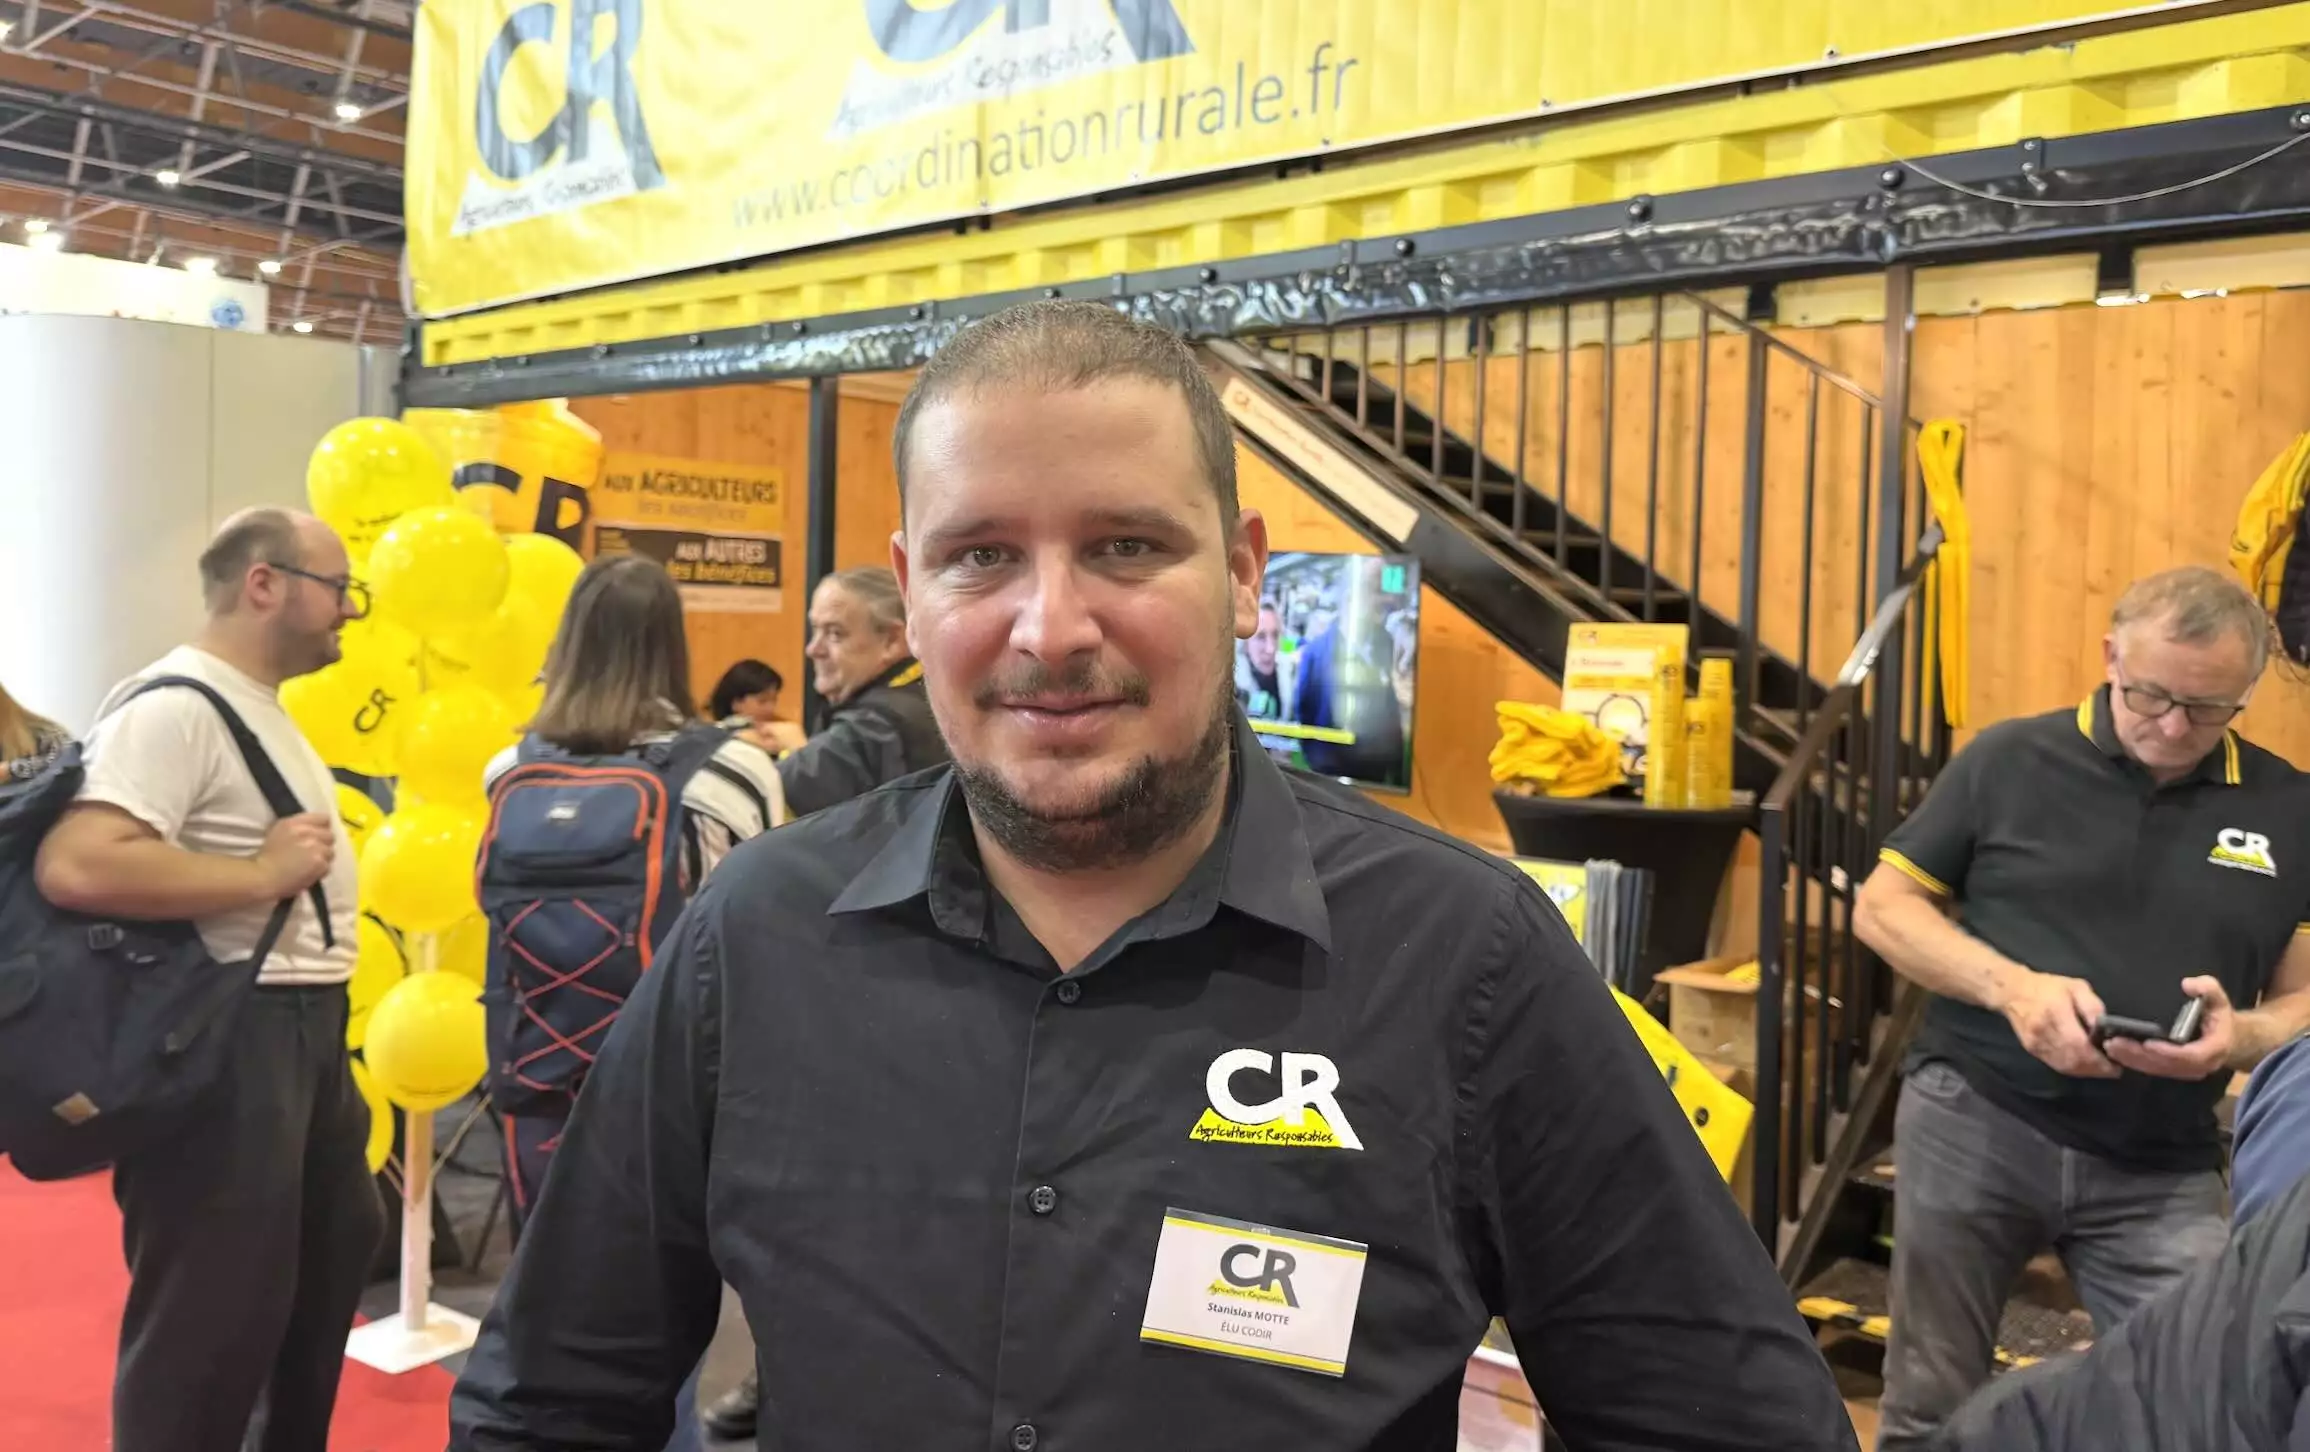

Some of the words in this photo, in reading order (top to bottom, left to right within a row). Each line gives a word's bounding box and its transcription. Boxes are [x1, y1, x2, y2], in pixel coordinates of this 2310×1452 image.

[475, 0, 666, 191] CR
[732, 41, 1358, 228] www.coordinationrurale.fr
[353, 688, 397, 734] CR
[2217, 827, 2277, 872] CR
[1205, 1048, 1365, 1151] CR
[1196, 1124, 1263, 1143] Agriculteurs
[1265, 1127, 1334, 1147] Responsables
[1220, 1243, 1300, 1308] CR
[1207, 1302, 1252, 1319] Stanislas
[1254, 1311, 1289, 1325] MOTTE
[1220, 1321, 1239, 1334] ÉLU
[1241, 1326, 1272, 1341] CODIR
